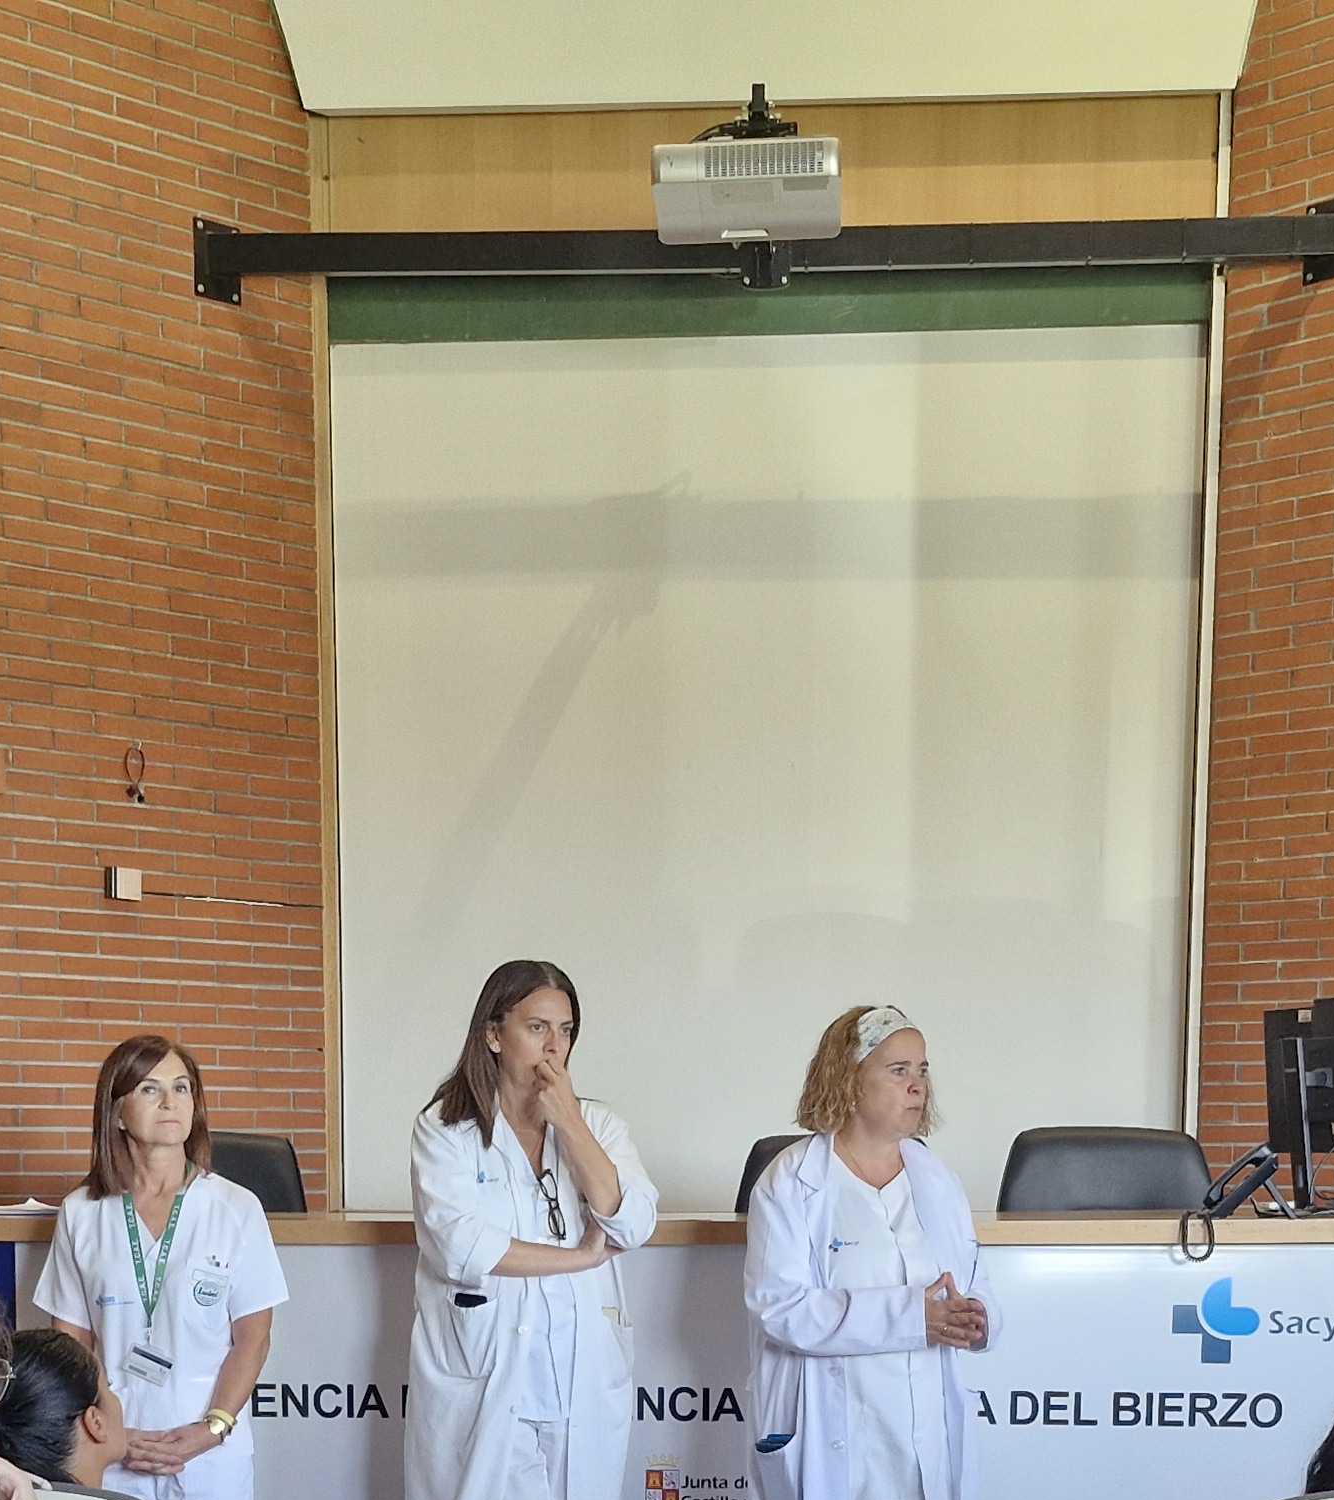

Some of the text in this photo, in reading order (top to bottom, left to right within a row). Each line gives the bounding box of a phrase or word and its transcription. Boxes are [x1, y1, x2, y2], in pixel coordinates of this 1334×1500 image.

[251, 1383, 390, 1419] ENCIA
[635, 1386, 745, 1422] NCIA
[1009, 1390, 1098, 1426] DEL
[1112, 1391, 1283, 1428] BIERZO
[681, 1475, 728, 1489] Junta
